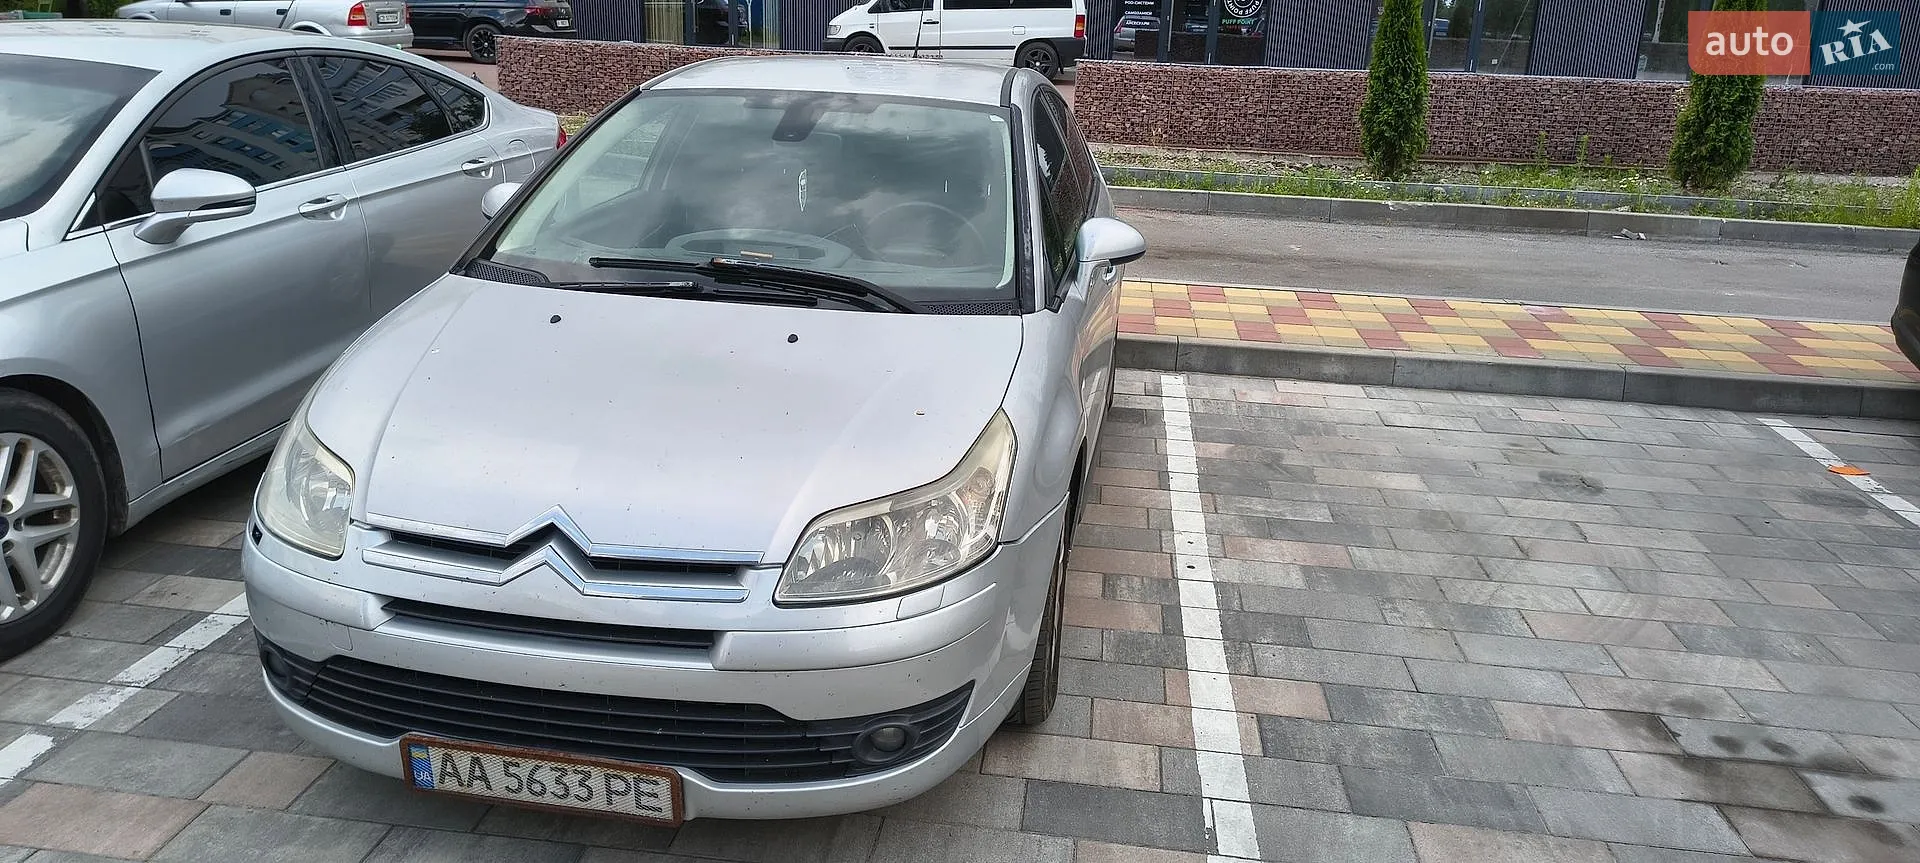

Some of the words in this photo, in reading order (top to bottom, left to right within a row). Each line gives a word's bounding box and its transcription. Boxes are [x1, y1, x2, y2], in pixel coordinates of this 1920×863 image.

[1244, 0, 1260, 15] PUFF
[438, 752, 492, 791] AA
[502, 760, 594, 801] 5633
[603, 772, 663, 814] PE
